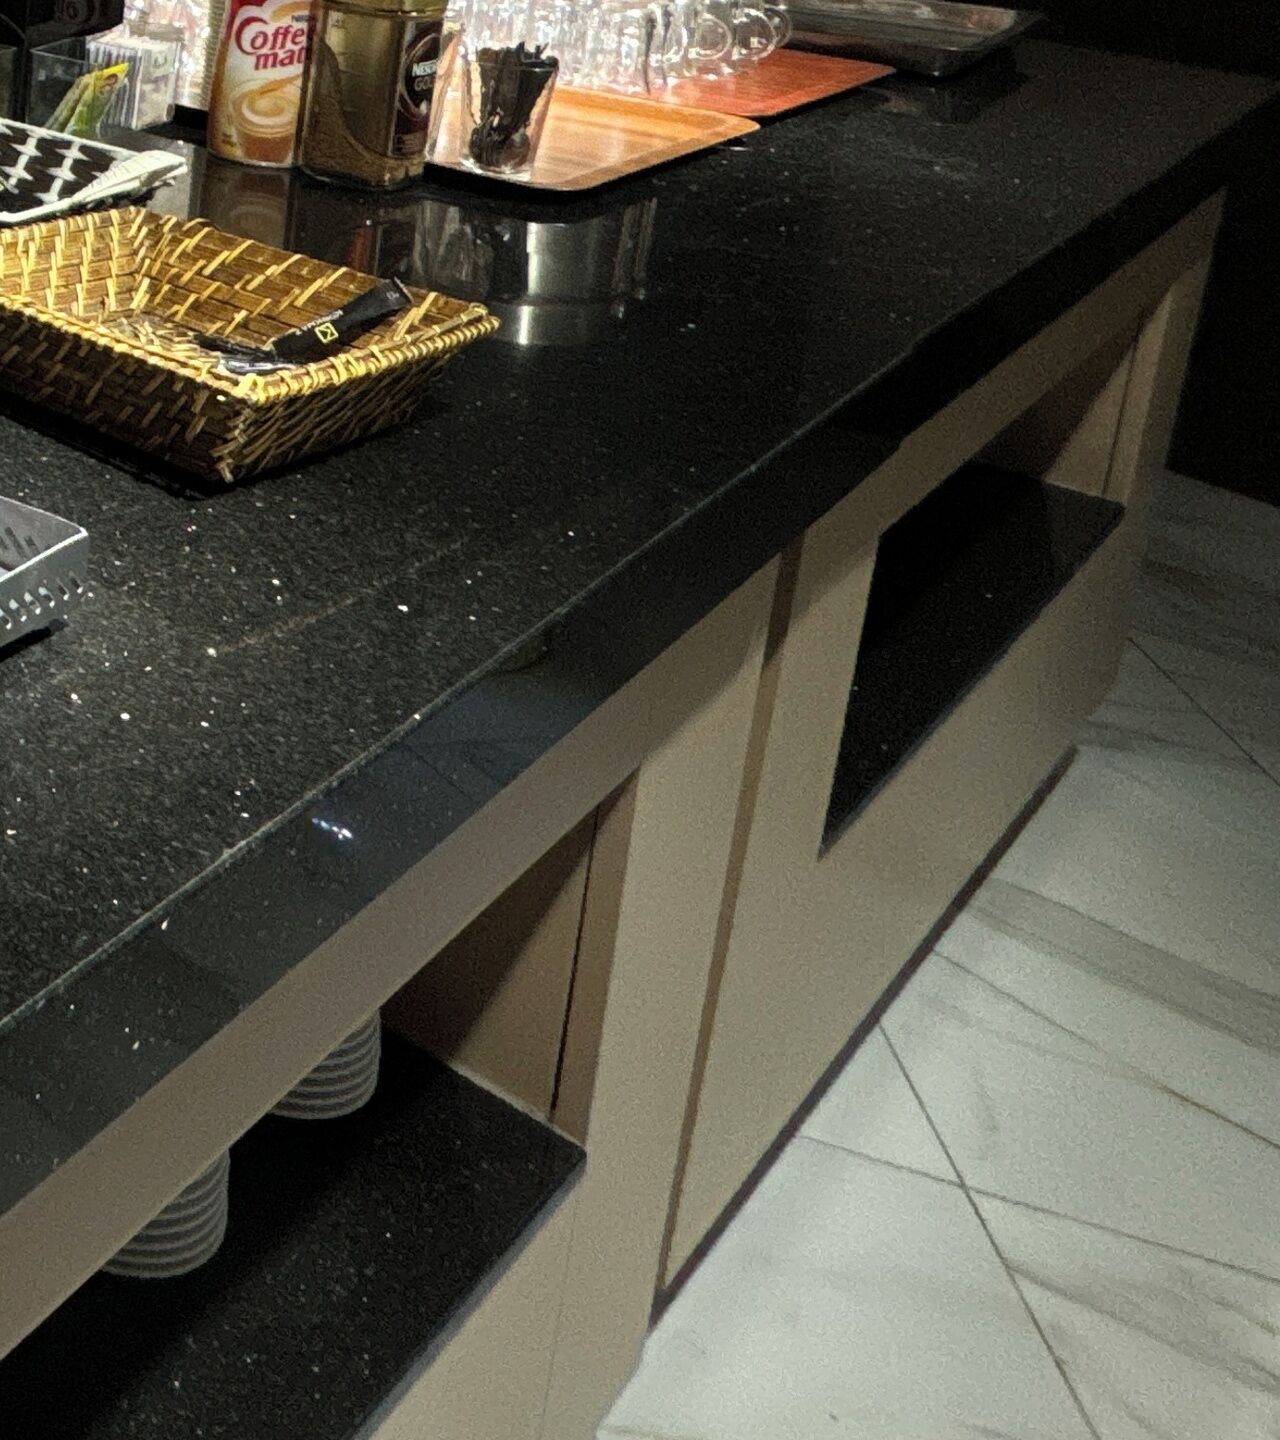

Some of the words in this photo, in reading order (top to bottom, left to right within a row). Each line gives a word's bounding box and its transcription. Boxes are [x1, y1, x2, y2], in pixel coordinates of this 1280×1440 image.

[235, 16, 306, 55] Coffe
[254, 46, 306, 71] mat
[414, 76, 433, 91] GO
